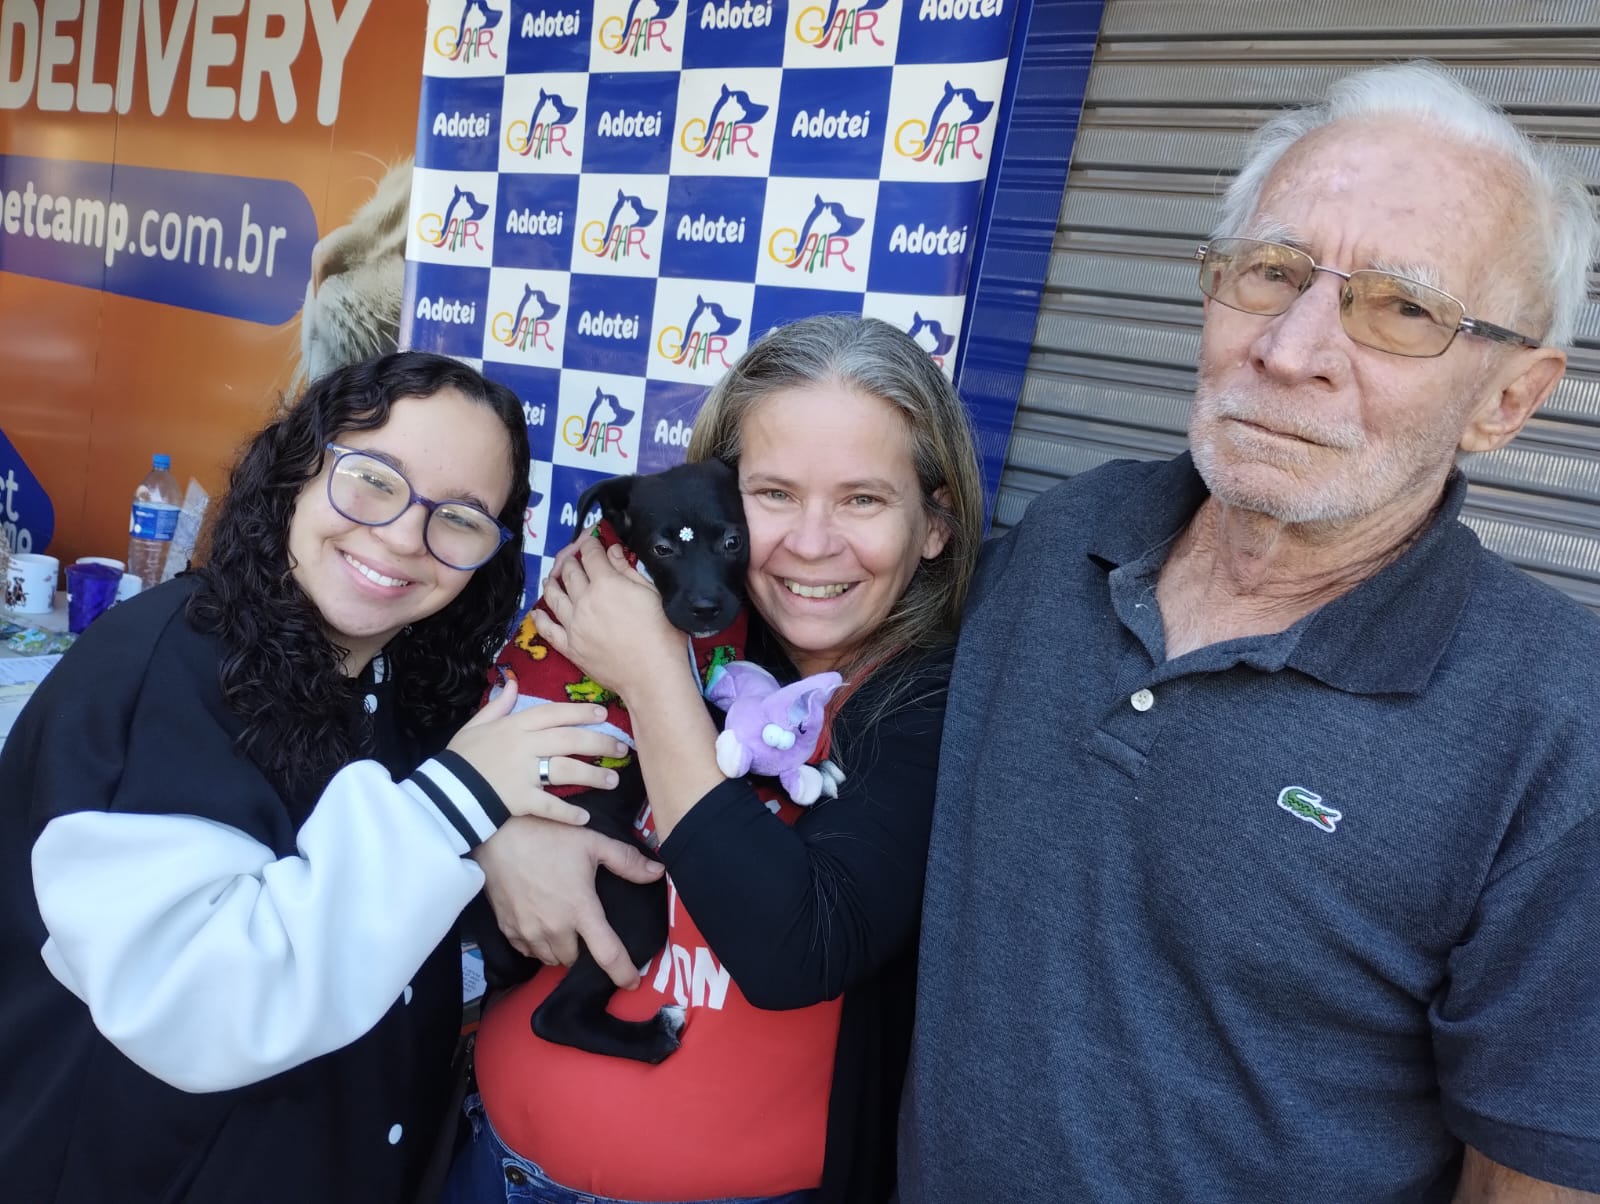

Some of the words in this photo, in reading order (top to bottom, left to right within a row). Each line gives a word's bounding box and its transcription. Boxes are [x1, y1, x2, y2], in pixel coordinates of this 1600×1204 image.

[521, 10, 580, 38] Adotei
[700, 0, 773, 30] Adotei
[795, 6, 885, 52] GAAR
[433, 26, 498, 63] GAAR
[598, 16, 672, 57] GAAR
[0, 0, 372, 127] DELIVERY
[433, 112, 490, 138] Adotei
[506, 120, 572, 160] GAAR
[598, 110, 662, 138] Adotei
[680, 118, 760, 161] GAAR
[791, 108, 870, 139] Adotei
[894, 119, 983, 166] GAAR
[0, 181, 287, 278] etcamp.com.br
[416, 213, 484, 252] GAAR
[506, 208, 563, 236] Adotei
[580, 220, 650, 262] GAAR
[677, 213, 746, 243] Adotei
[889, 223, 968, 255] Adotei
[768, 228, 855, 273] GAAR
[417, 297, 475, 325] Adotei
[578, 311, 639, 340] Adotei
[491, 312, 554, 352] GAAR
[657, 326, 732, 370] GAAR
[562, 415, 628, 458] GAAR
